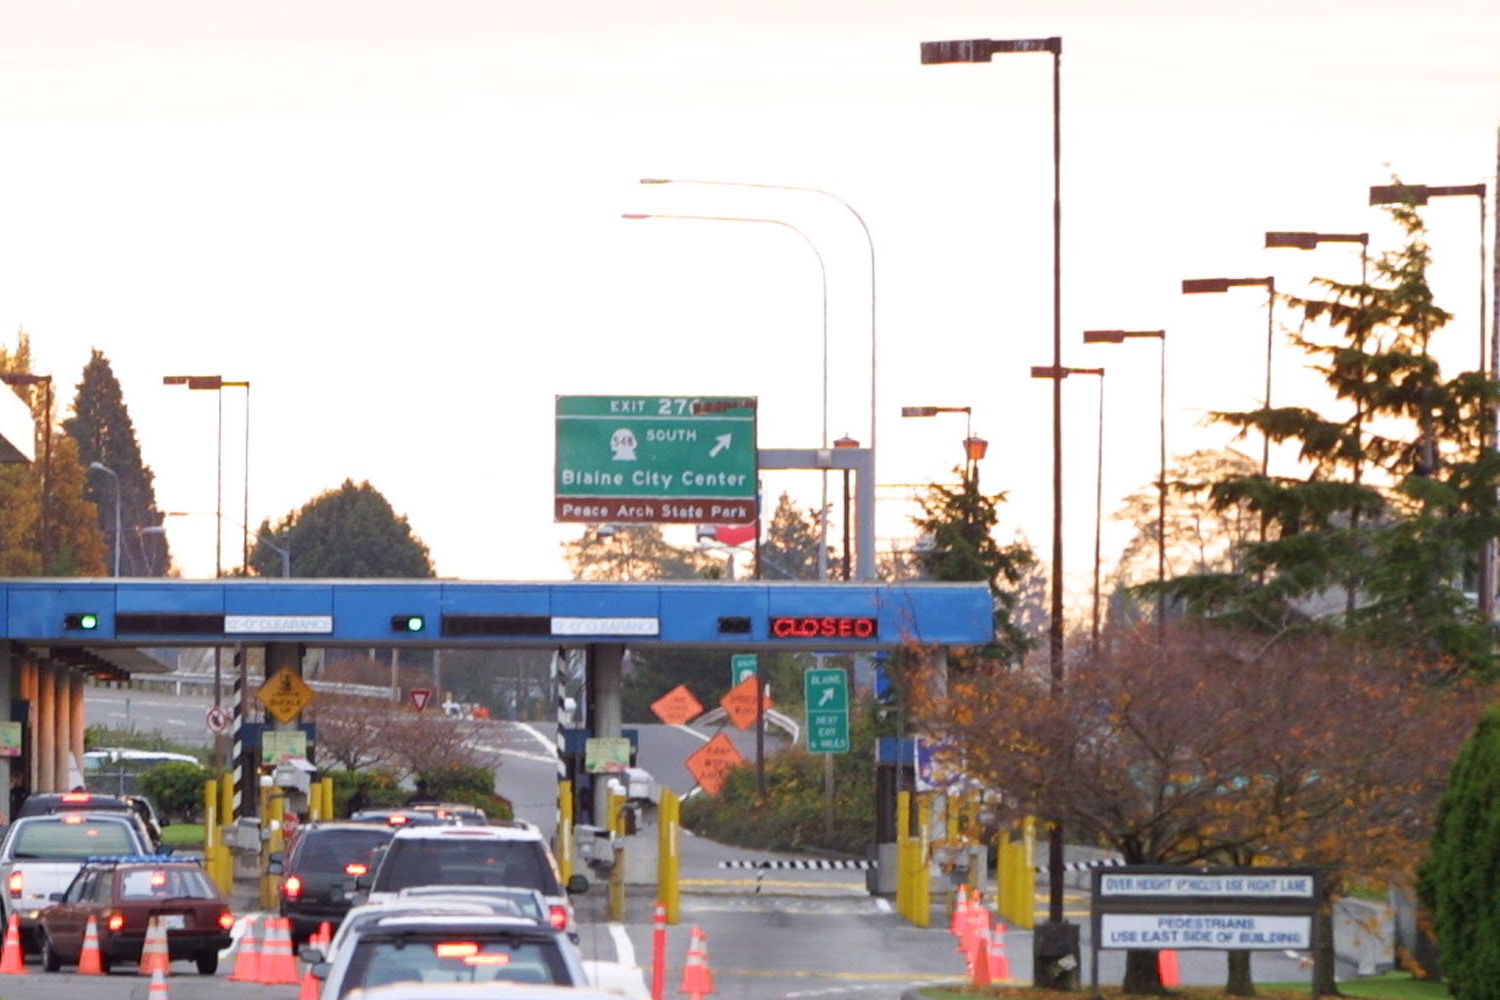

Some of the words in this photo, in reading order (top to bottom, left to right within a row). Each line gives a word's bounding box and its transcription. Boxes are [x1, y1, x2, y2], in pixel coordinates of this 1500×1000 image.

[610, 400, 645, 412] EXIT
[646, 429, 697, 441] SOUTH
[561, 469, 624, 485] Blaine
[632, 470, 673, 489] City
[682, 472, 746, 486] Center
[562, 504, 609, 516] Peace
[617, 504, 654, 517] Arch
[661, 504, 703, 517] State
[711, 505, 747, 518] Park
[773, 617, 873, 638] CLOSED
[1106, 879, 1131, 890] OVER
[1137, 879, 1171, 890] HEIGHT
[1226, 879, 1243, 891] USE
[1280, 880, 1308, 892] LANE
[1157, 918, 1255, 929] PEDESTRIANS
[1110, 931, 1137, 942] USE
[1141, 931, 1178, 942] EAST
[1182, 931, 1211, 942] SIDE
[1215, 932, 1234, 943] OF
[1239, 932, 1300, 943] BUILDING
